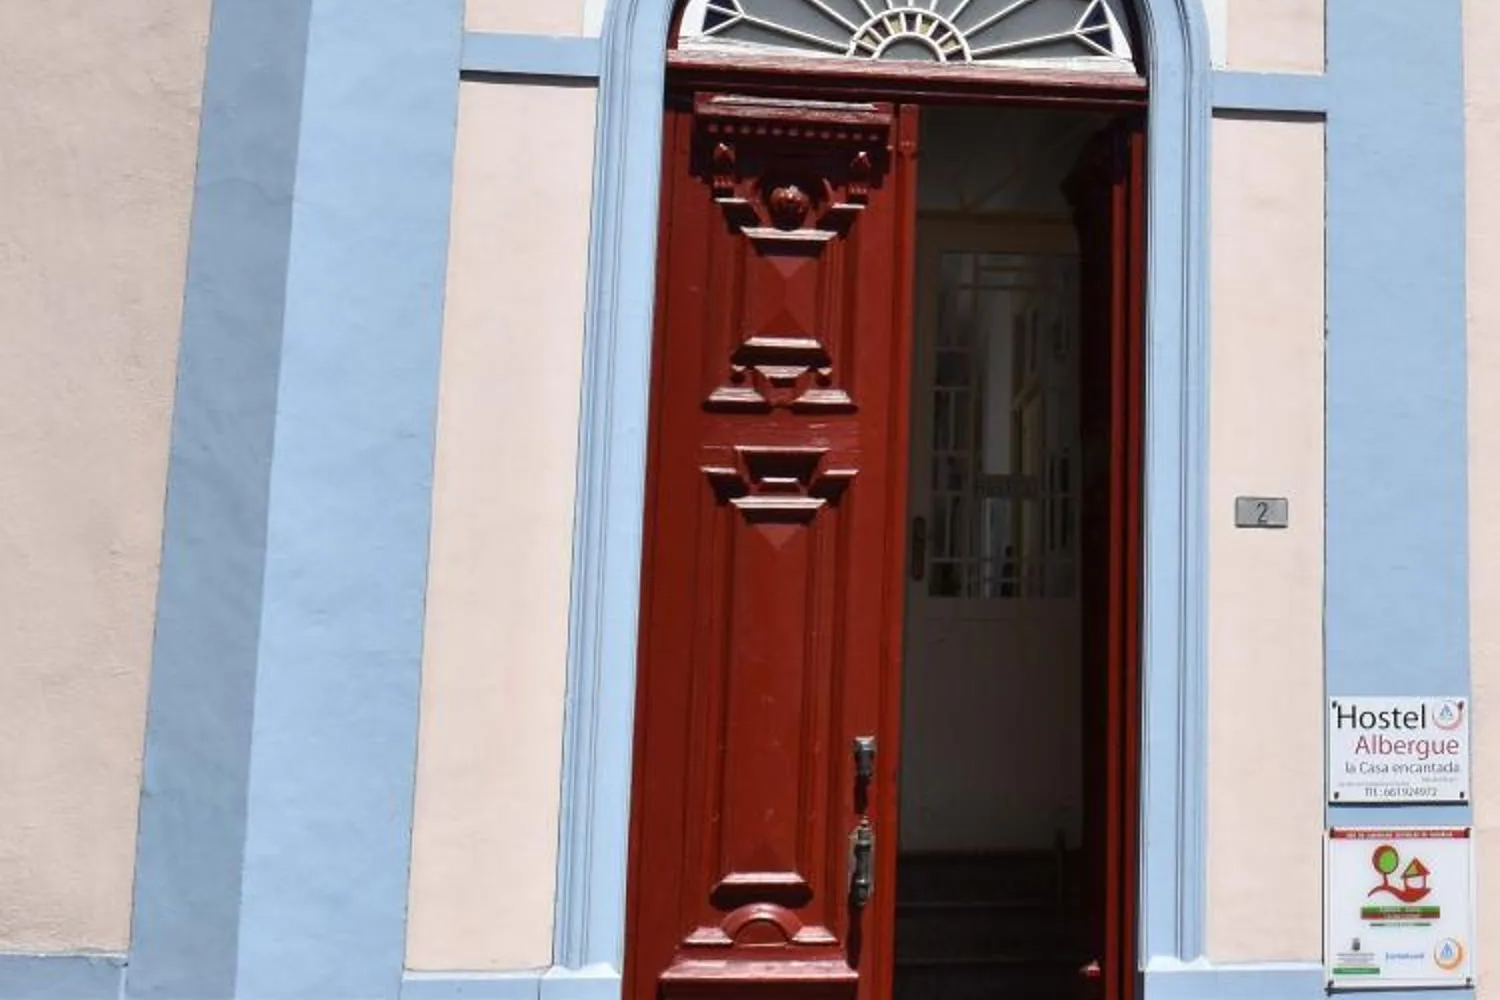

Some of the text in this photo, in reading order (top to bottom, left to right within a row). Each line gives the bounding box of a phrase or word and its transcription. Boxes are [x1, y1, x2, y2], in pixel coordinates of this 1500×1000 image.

[1256, 501, 1268, 525] 2
[1337, 703, 1426, 730] Hostel
[1354, 733, 1460, 761] Albergue
[1345, 761, 1460, 774] la Casa encantada
